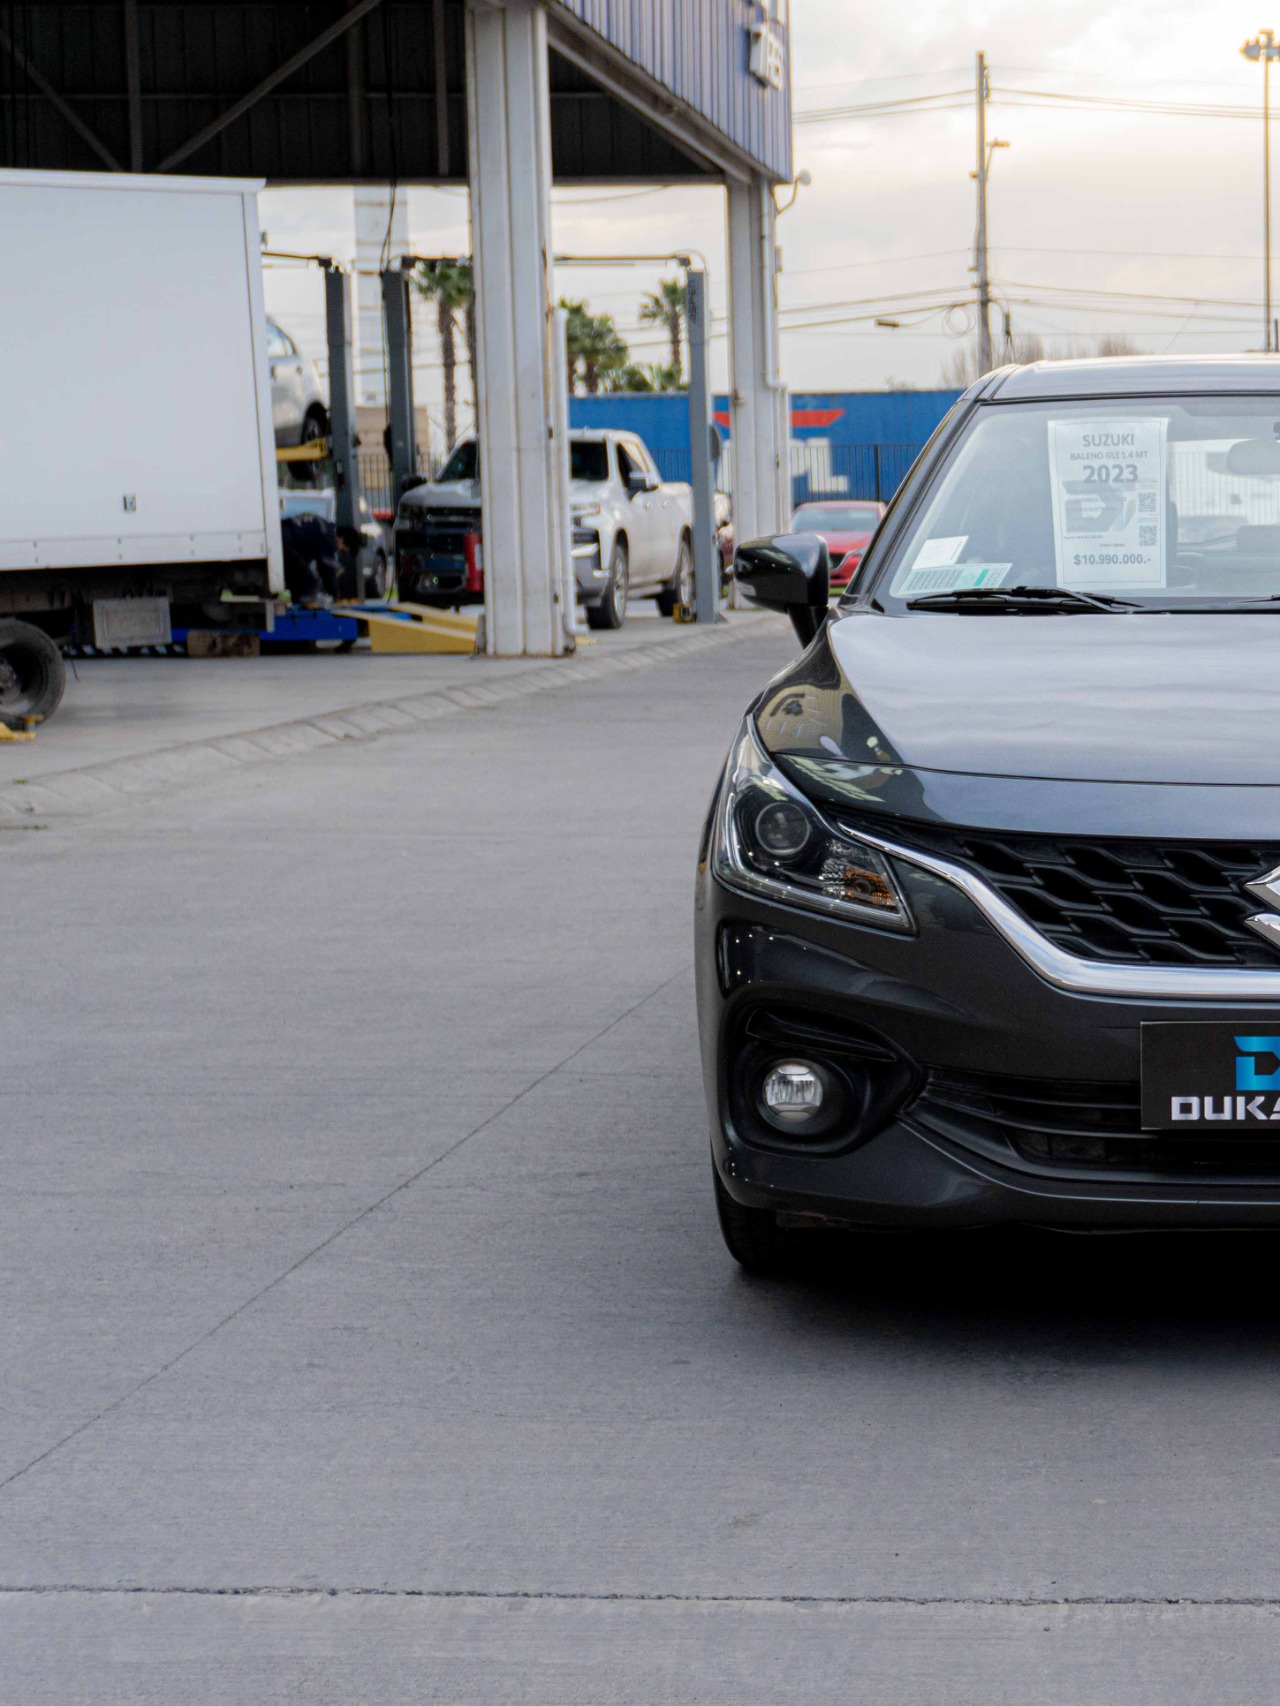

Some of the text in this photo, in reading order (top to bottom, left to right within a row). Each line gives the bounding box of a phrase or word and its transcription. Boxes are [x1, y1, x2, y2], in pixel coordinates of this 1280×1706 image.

[1082, 433, 1135, 447] SUZUKI
[1070, 452, 1103, 460] BALENO
[1106, 452, 1121, 460] GLS
[1135, 451, 1148, 459] MT
[1082, 464, 1138, 484] 2023
